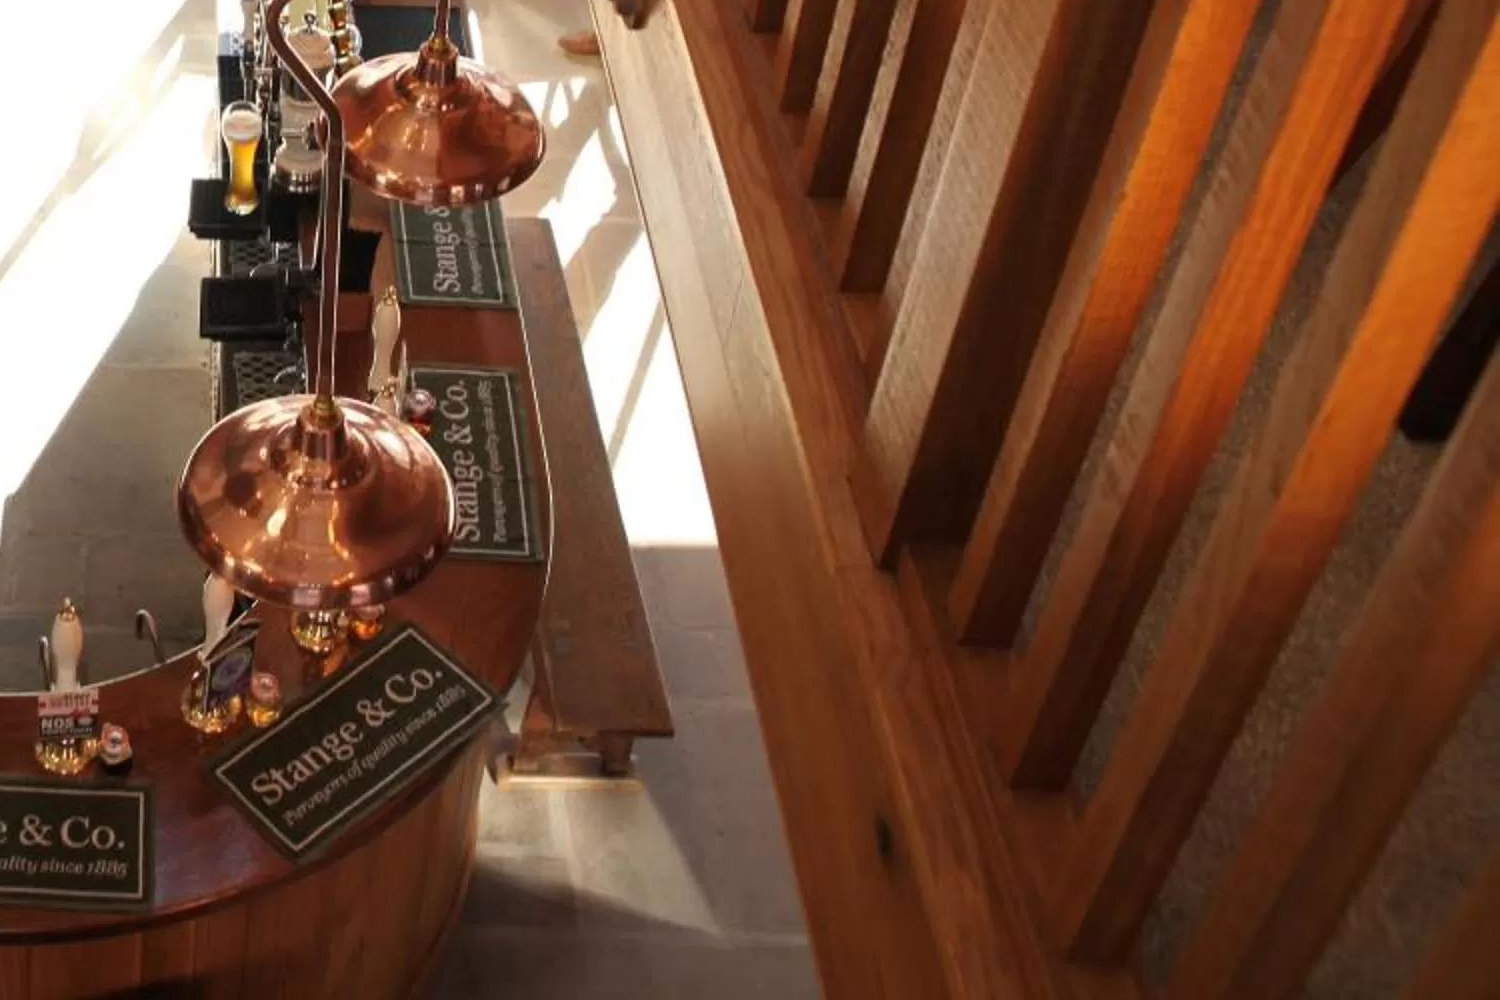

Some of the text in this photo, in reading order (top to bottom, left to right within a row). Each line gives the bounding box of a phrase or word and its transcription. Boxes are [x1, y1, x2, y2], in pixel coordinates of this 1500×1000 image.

[432, 220, 461, 293] Stange
[439, 379, 484, 543] Stange & Co.
[250, 667, 445, 807] Stange & Co.
[18, 813, 53, 847] &
[59, 815, 126, 851] Co.
